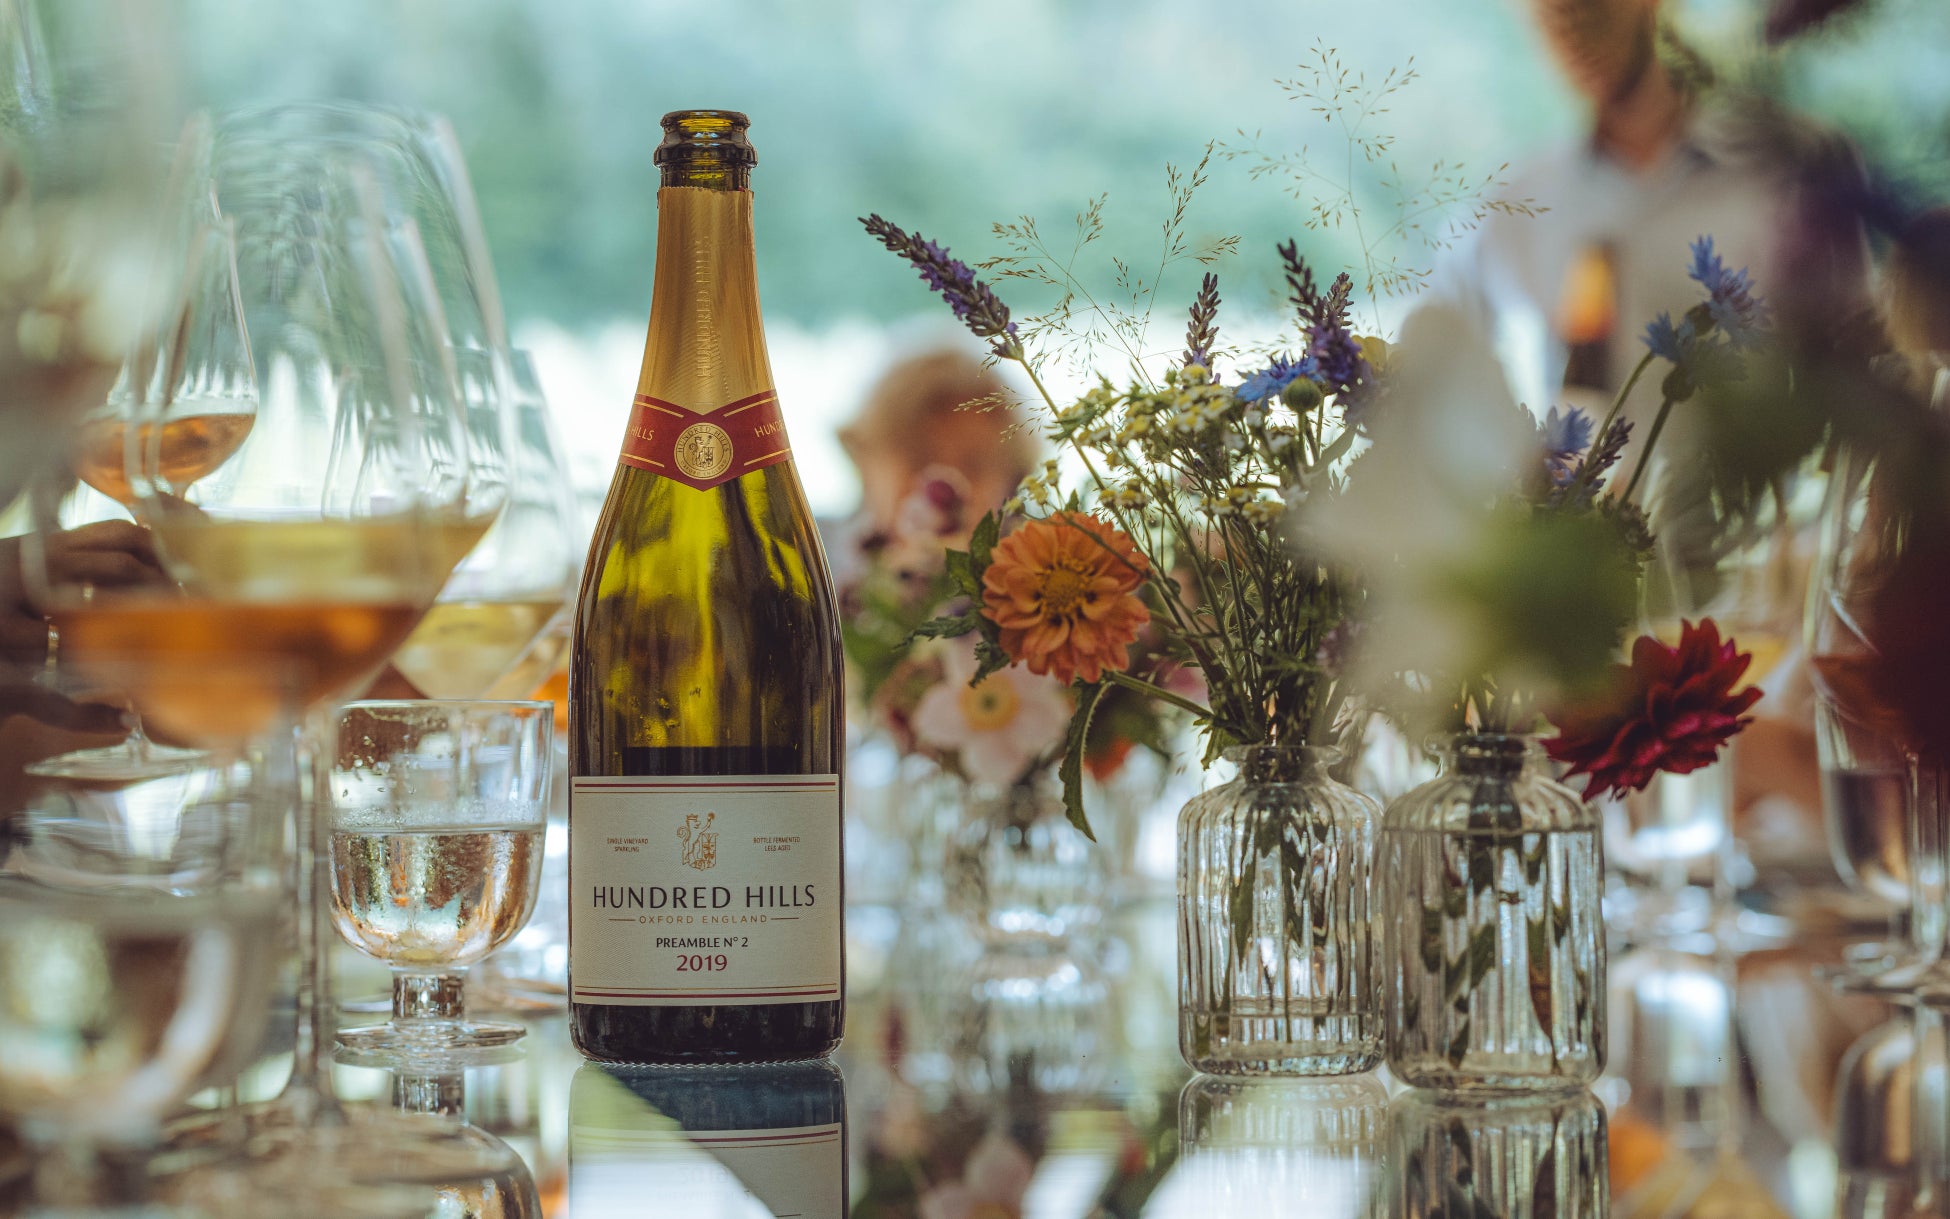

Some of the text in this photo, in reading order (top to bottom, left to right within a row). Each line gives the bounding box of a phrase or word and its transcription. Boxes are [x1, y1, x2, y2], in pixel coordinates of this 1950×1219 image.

[677, 426, 710, 453] HUNDRED
[593, 884, 815, 909] HUNDRED HILLS
[639, 914, 767, 924] OXFORD ENGLAND
[656, 937, 720, 948] PREAMBLE
[741, 936, 749, 948] 2
[676, 954, 728, 972] 2019
